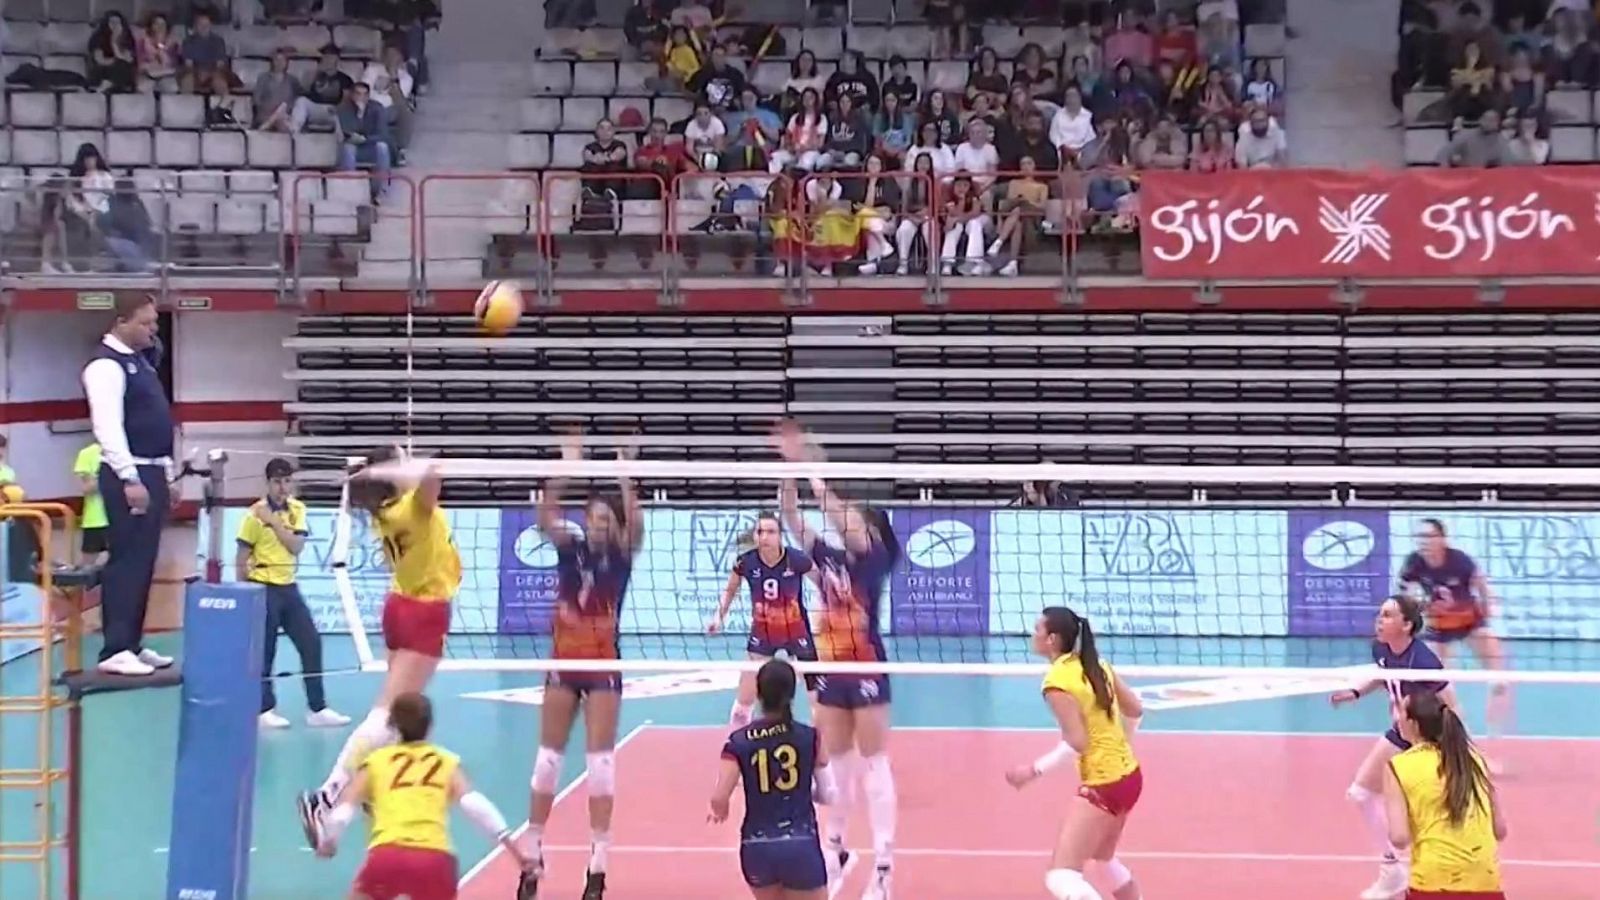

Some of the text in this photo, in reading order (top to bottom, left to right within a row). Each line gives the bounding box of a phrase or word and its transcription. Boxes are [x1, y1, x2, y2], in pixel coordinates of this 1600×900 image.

[1151, 194, 1299, 264] gijón
[1422, 192, 1576, 262] gijón
[763, 578, 779, 600] 9
[907, 576, 973, 588] DEPORTE
[1304, 577, 1371, 590] DEPORTE
[389, 751, 445, 790] 22
[751, 743, 799, 793] 13
